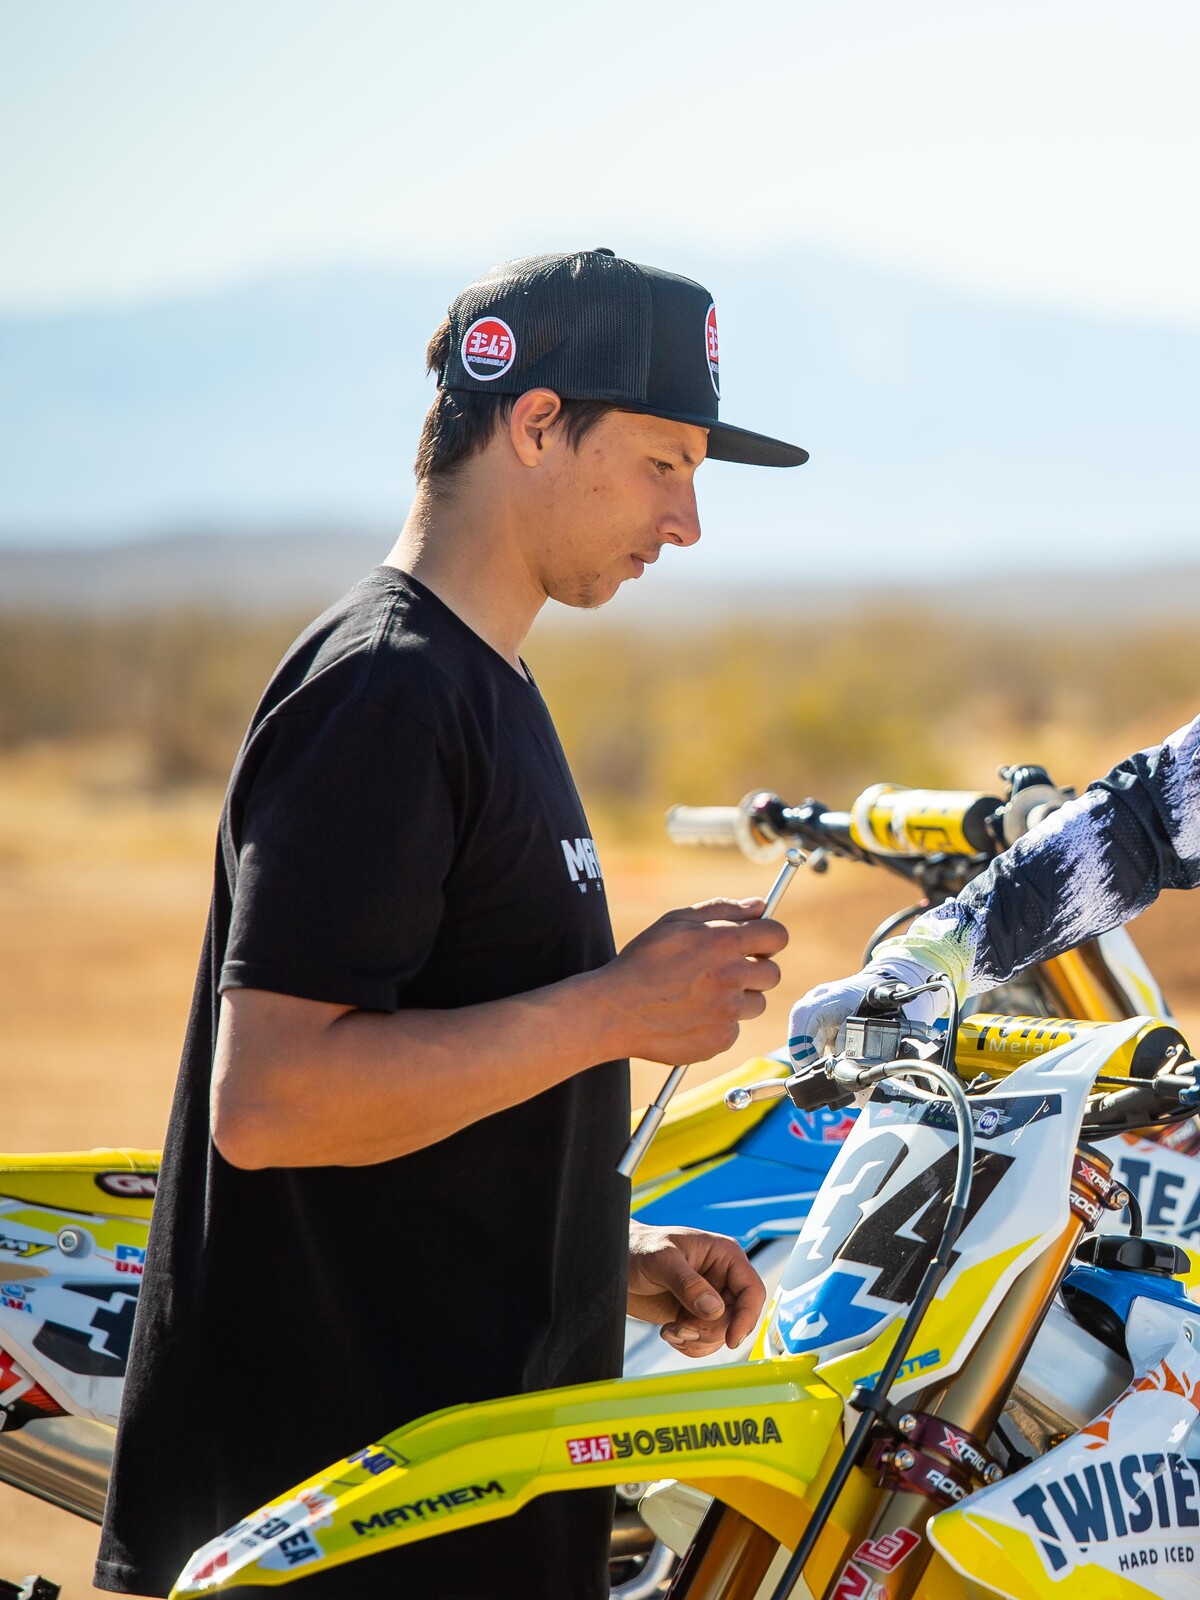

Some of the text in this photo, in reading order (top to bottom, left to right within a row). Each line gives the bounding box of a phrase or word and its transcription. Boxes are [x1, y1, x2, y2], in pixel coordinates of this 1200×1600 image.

[469, 331, 510, 357] ヨシムラ
[989, 1038, 1063, 1053] Metal
[979, 1113, 998, 1128] FIM
[1078, 1161, 1111, 1193] XTRIG
[612, 1417, 782, 1458] YOSHIMURA
[939, 1426, 986, 1471] XTRIG
[568, 1440, 611, 1464] ヨシムラ
[926, 1469, 967, 1500] ROC
[352, 1481, 505, 1535] MAYHEM
[1119, 1549, 1158, 1571] HARD
[1165, 1547, 1195, 1564] ICED
